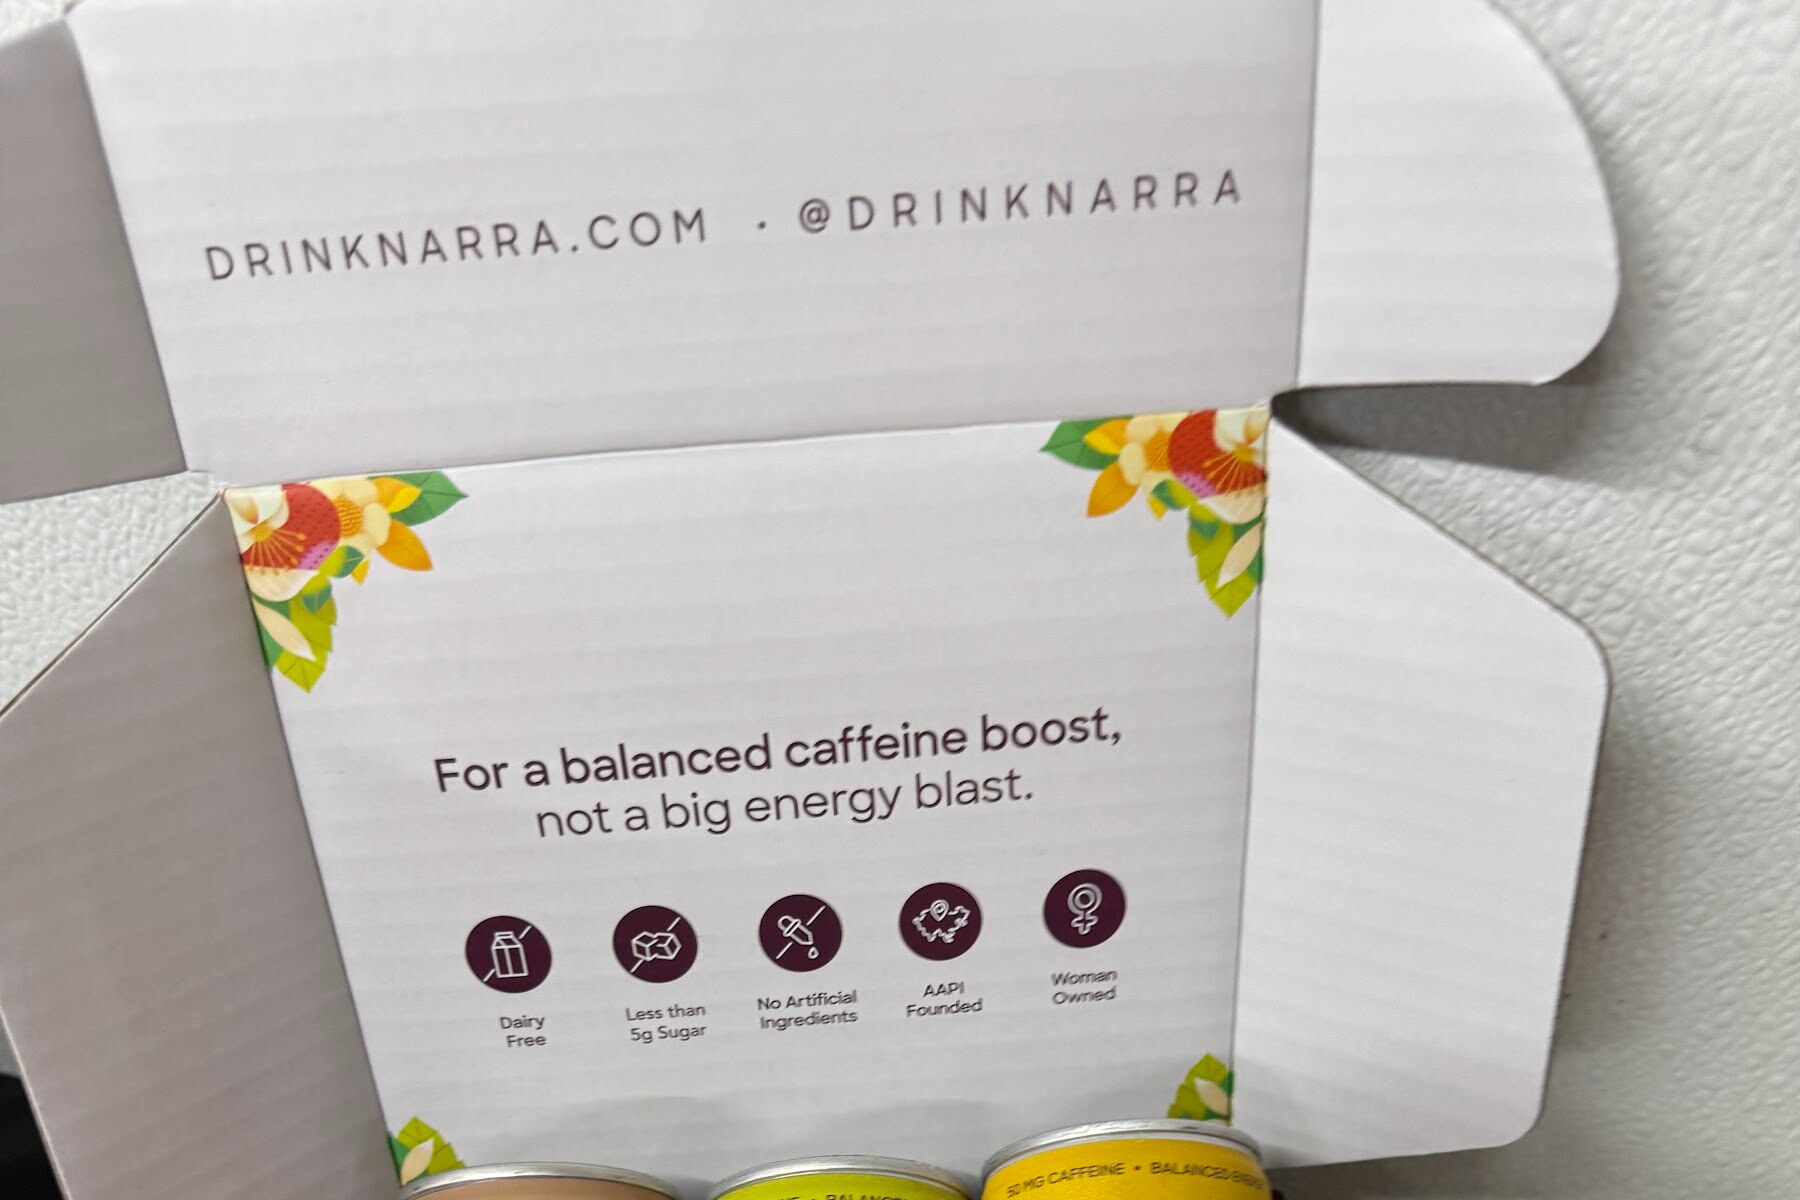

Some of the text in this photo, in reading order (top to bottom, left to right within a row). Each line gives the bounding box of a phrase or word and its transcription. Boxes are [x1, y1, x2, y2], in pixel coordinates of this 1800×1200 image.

[205, 168, 1241, 280] DRINKNARRA.COM @DRINKNARRA
[434, 705, 1122, 793] For a balanced caffeine boost,
[536, 766, 1033, 838] not a big energy blast.
[1051, 968, 1118, 987] Woman
[923, 981, 965, 998] AAPI
[1052, 986, 1117, 1007] Owned
[757, 990, 857, 1011] No Artificial
[906, 998, 983, 1018] Founded
[499, 1014, 545, 1031] Dairy
[625, 1003, 706, 1022] Less than
[760, 1009, 858, 1031] Ingredients
[507, 1033, 547, 1049] Free
[630, 1024, 707, 1044] 5g Sugar
[1047, 1162, 1125, 1185] CAFFEINE
[1149, 1162, 1229, 1181] BALANCED
